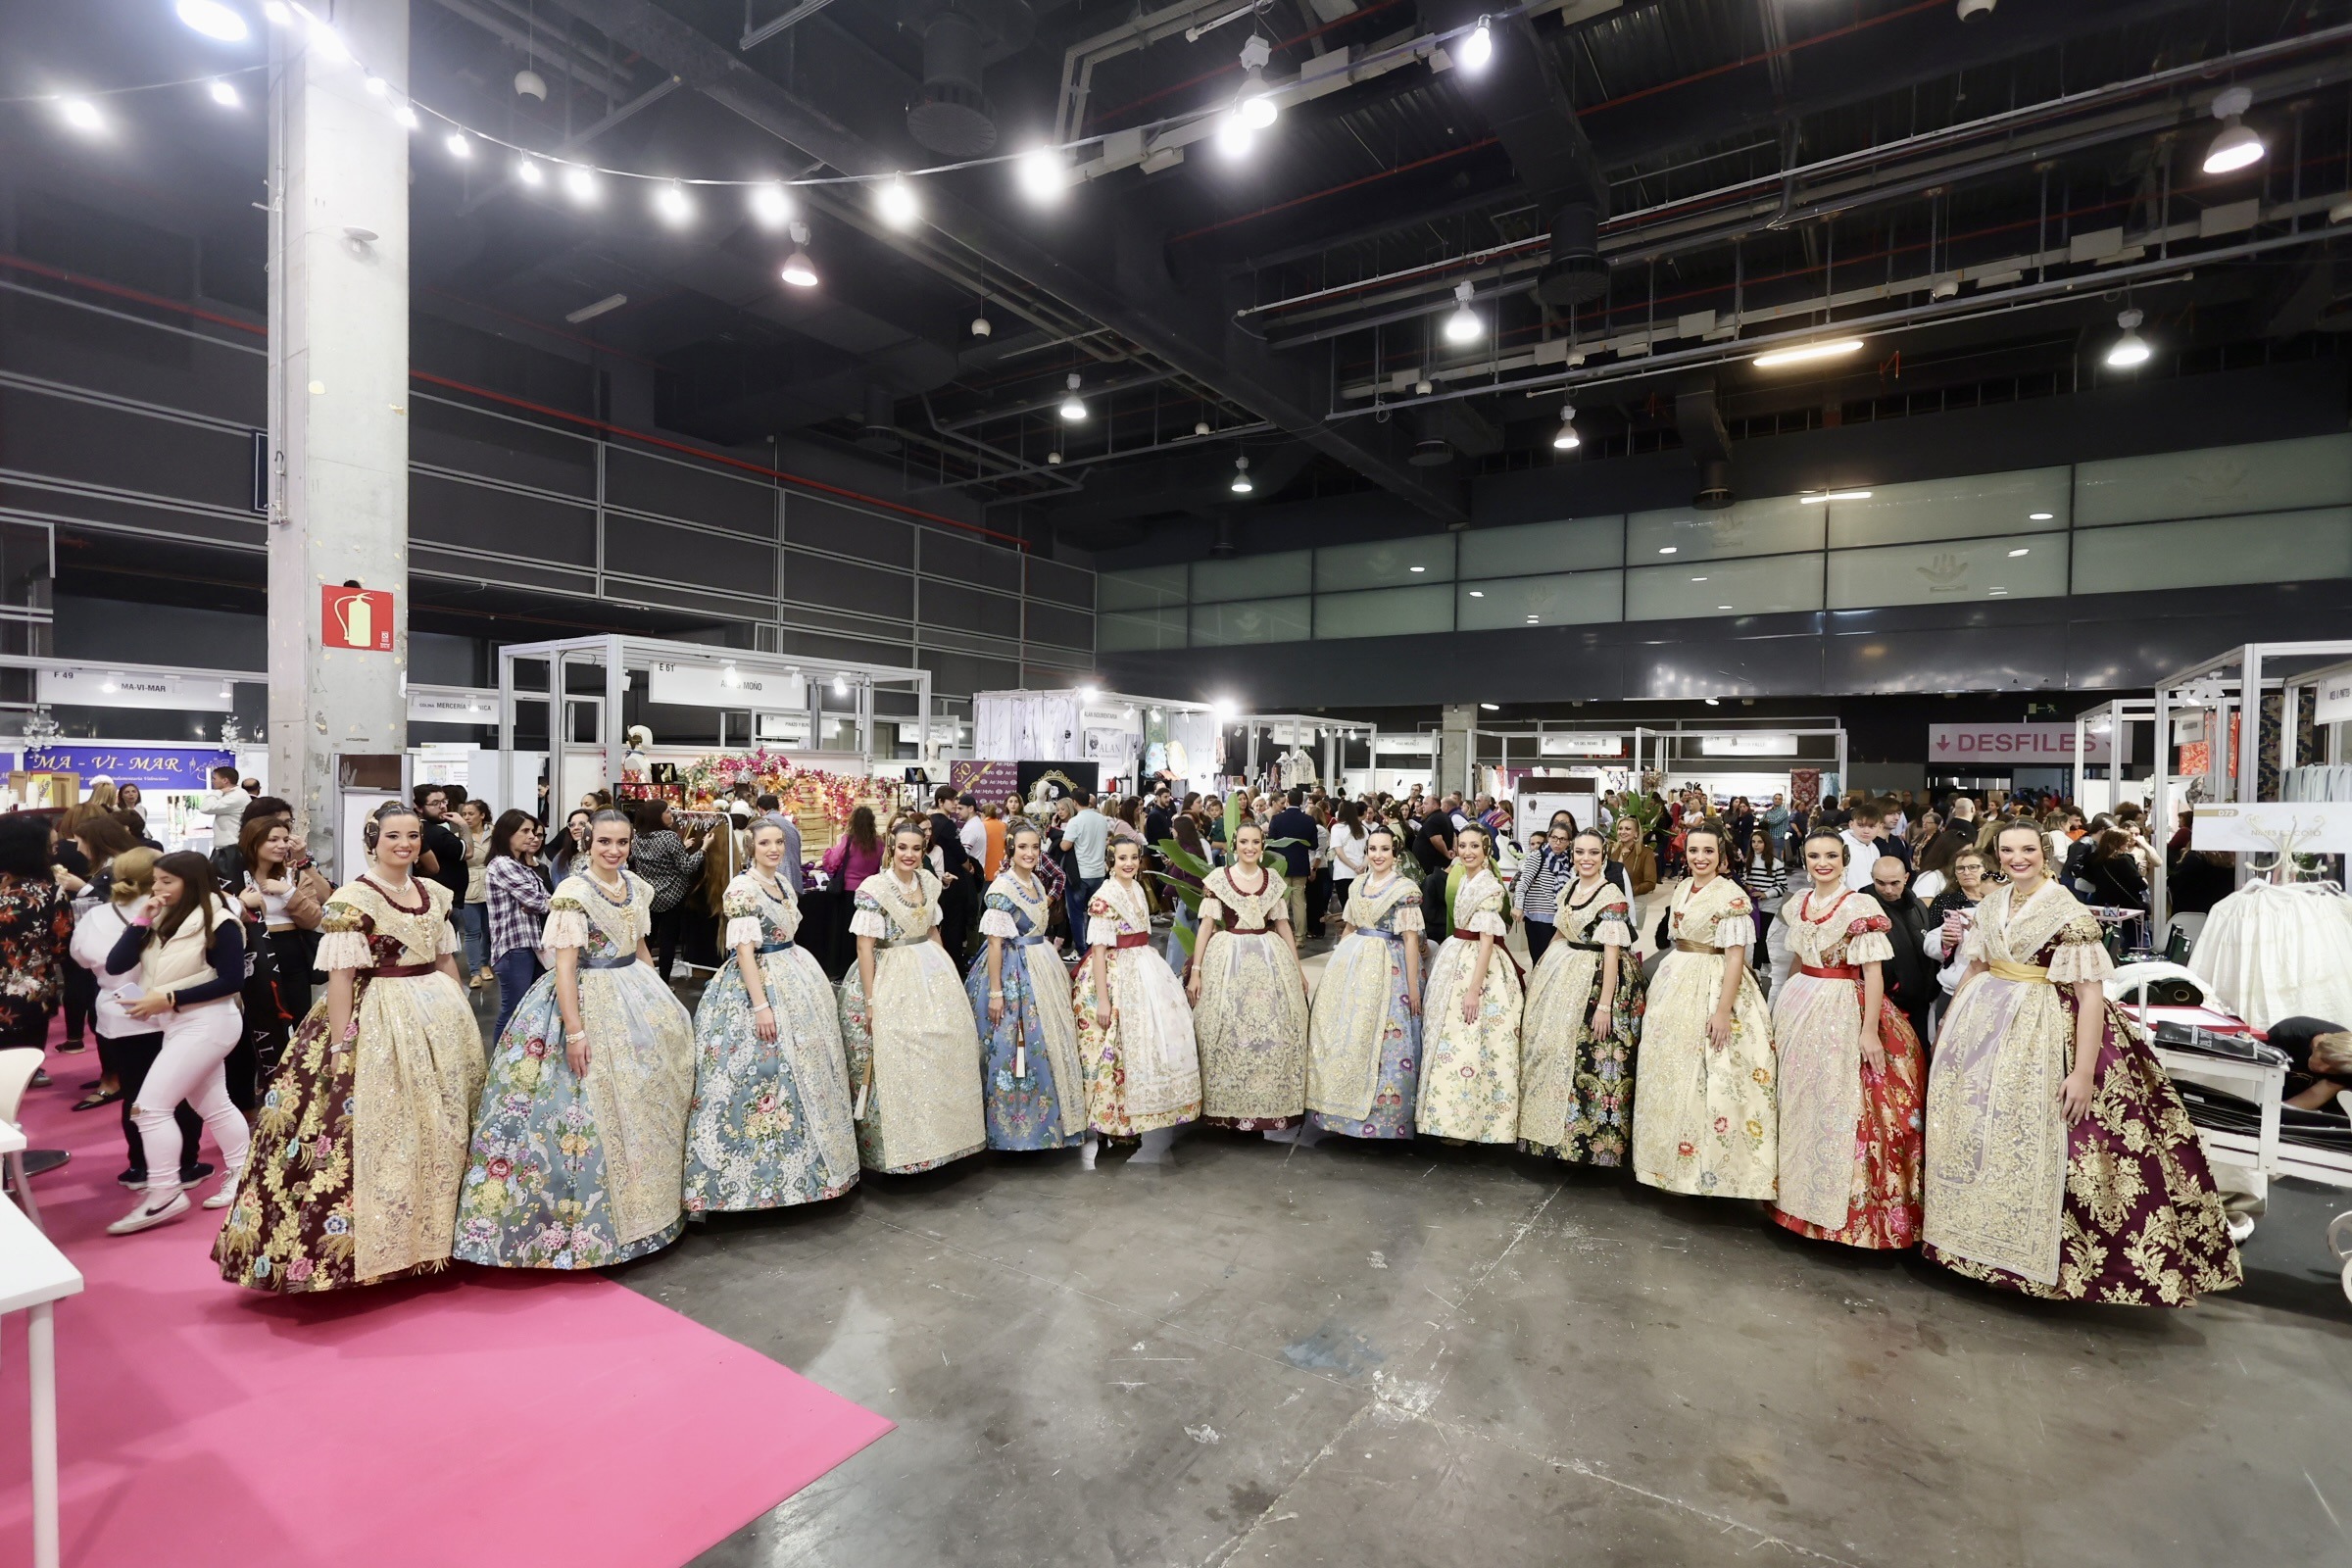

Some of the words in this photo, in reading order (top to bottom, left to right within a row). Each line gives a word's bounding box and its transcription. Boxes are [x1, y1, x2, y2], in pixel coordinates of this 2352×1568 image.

[121, 683, 166, 692] MA-VI-MAR
[743, 681, 762, 691] MOÑO
[1100, 743, 1120, 753] ALAN
[1959, 734, 2097, 752] DESFILES
[33, 755, 72, 770] MA
[129, 757, 183, 772] MAR
[254, 1030, 278, 1076] ALA
